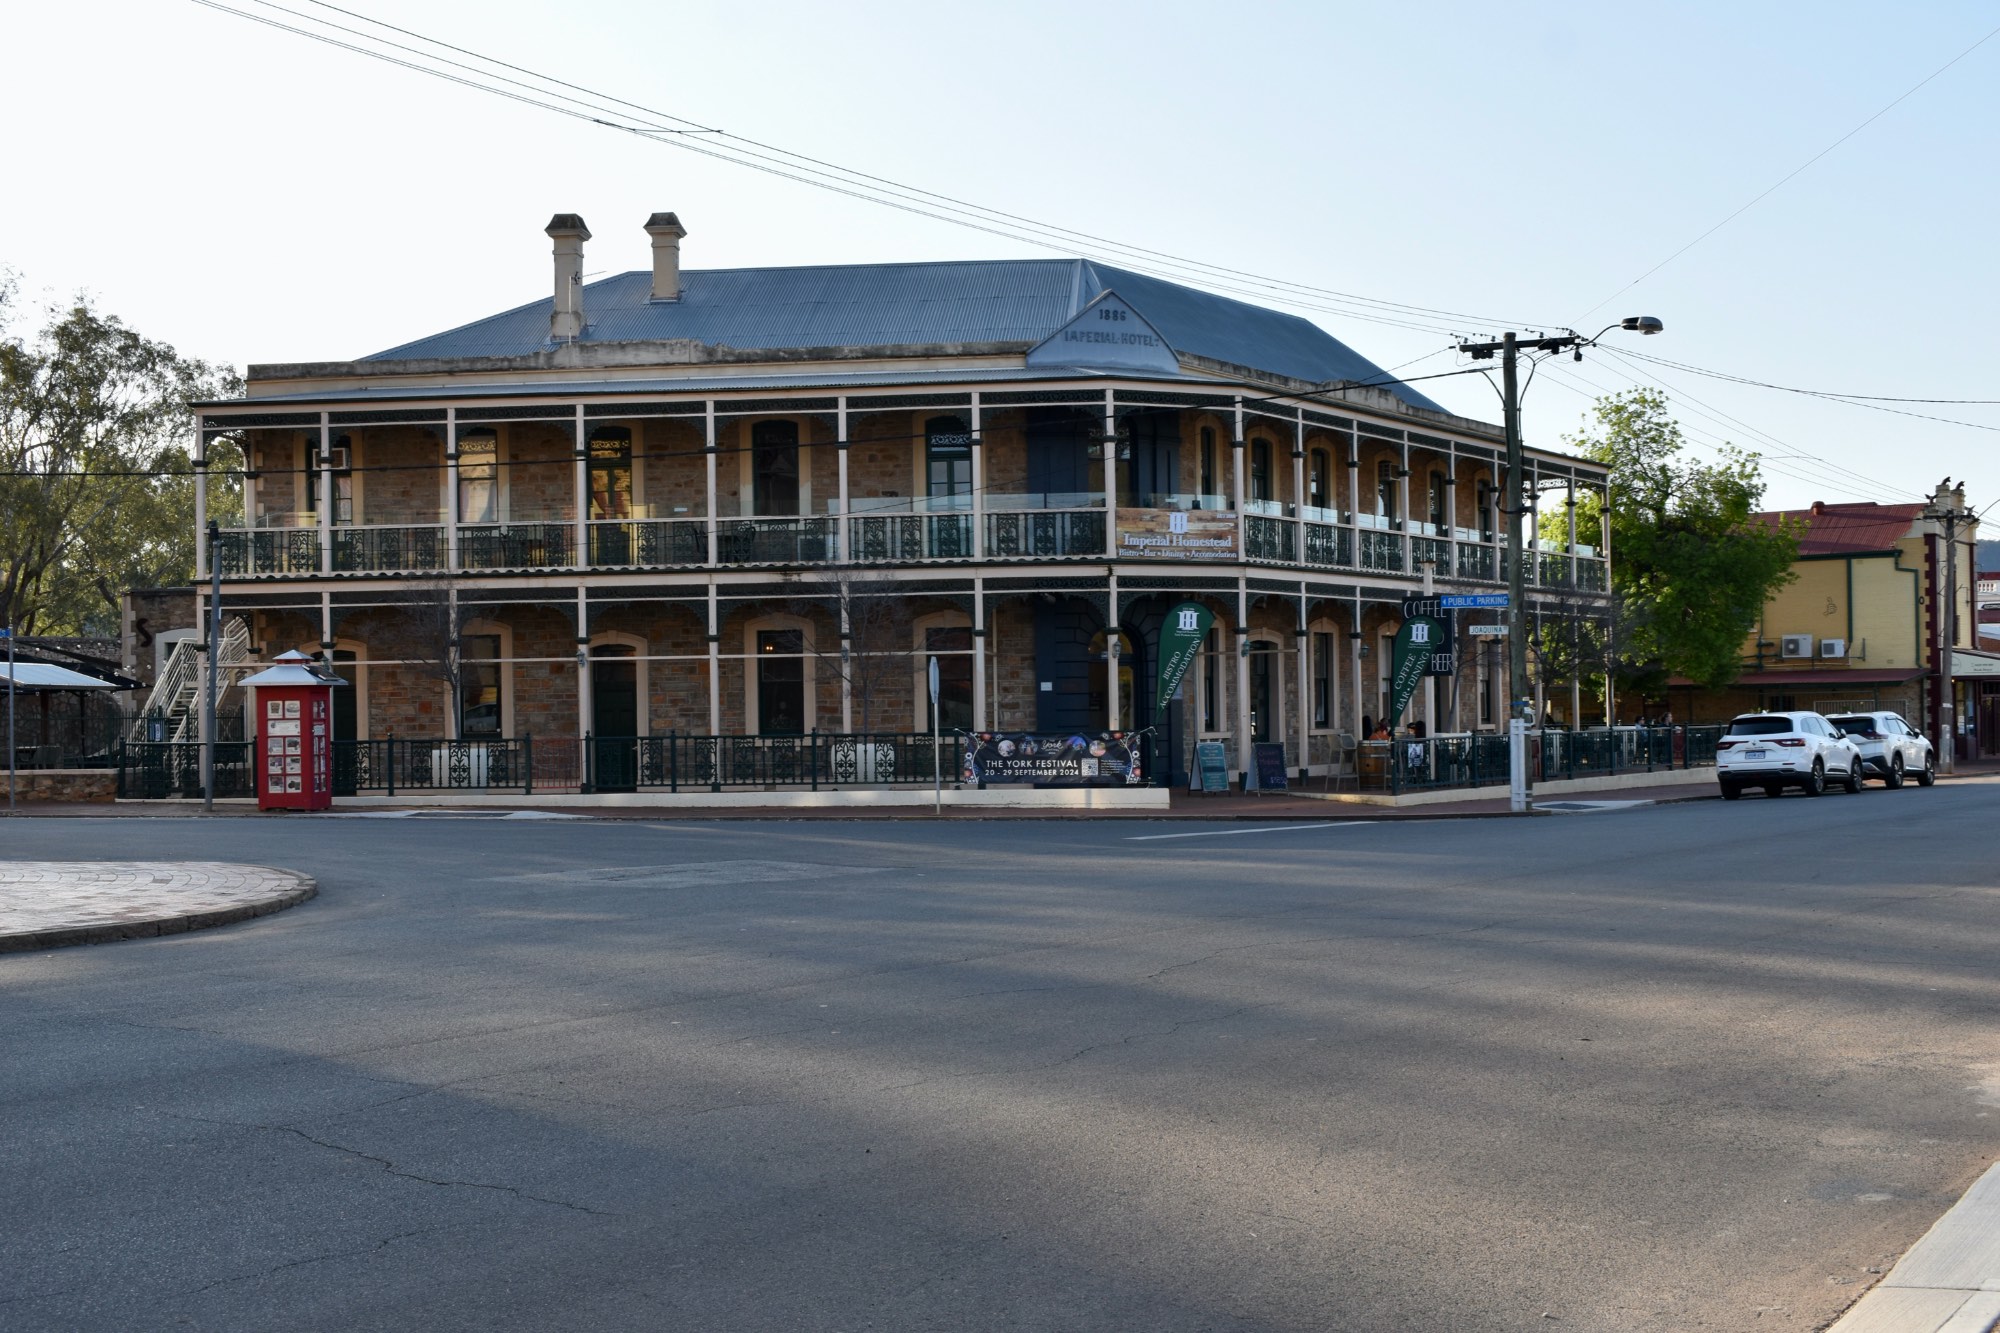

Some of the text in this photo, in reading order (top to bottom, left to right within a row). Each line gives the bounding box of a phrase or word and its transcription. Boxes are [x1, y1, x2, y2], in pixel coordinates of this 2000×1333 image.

[1064, 331, 1118, 344] IMPERIAL
[1124, 533, 1232, 549] Imperial Homestead
[1161, 550, 1186, 559] Dining
[1448, 596, 1508, 606] PUBLIC PARKING
[1471, 626, 1503, 634] JOAQUINA
[1162, 651, 1182, 680] BISTRO
[1431, 653, 1453, 671] BEER
[1160, 638, 1201, 710] ACCOMMODATION
[1394, 653, 1416, 690] COFFEE
[1396, 691, 1410, 711] BAR
[1408, 651, 1430, 687] DINING
[986, 760, 1078, 768] THE YORK FESTIVAL
